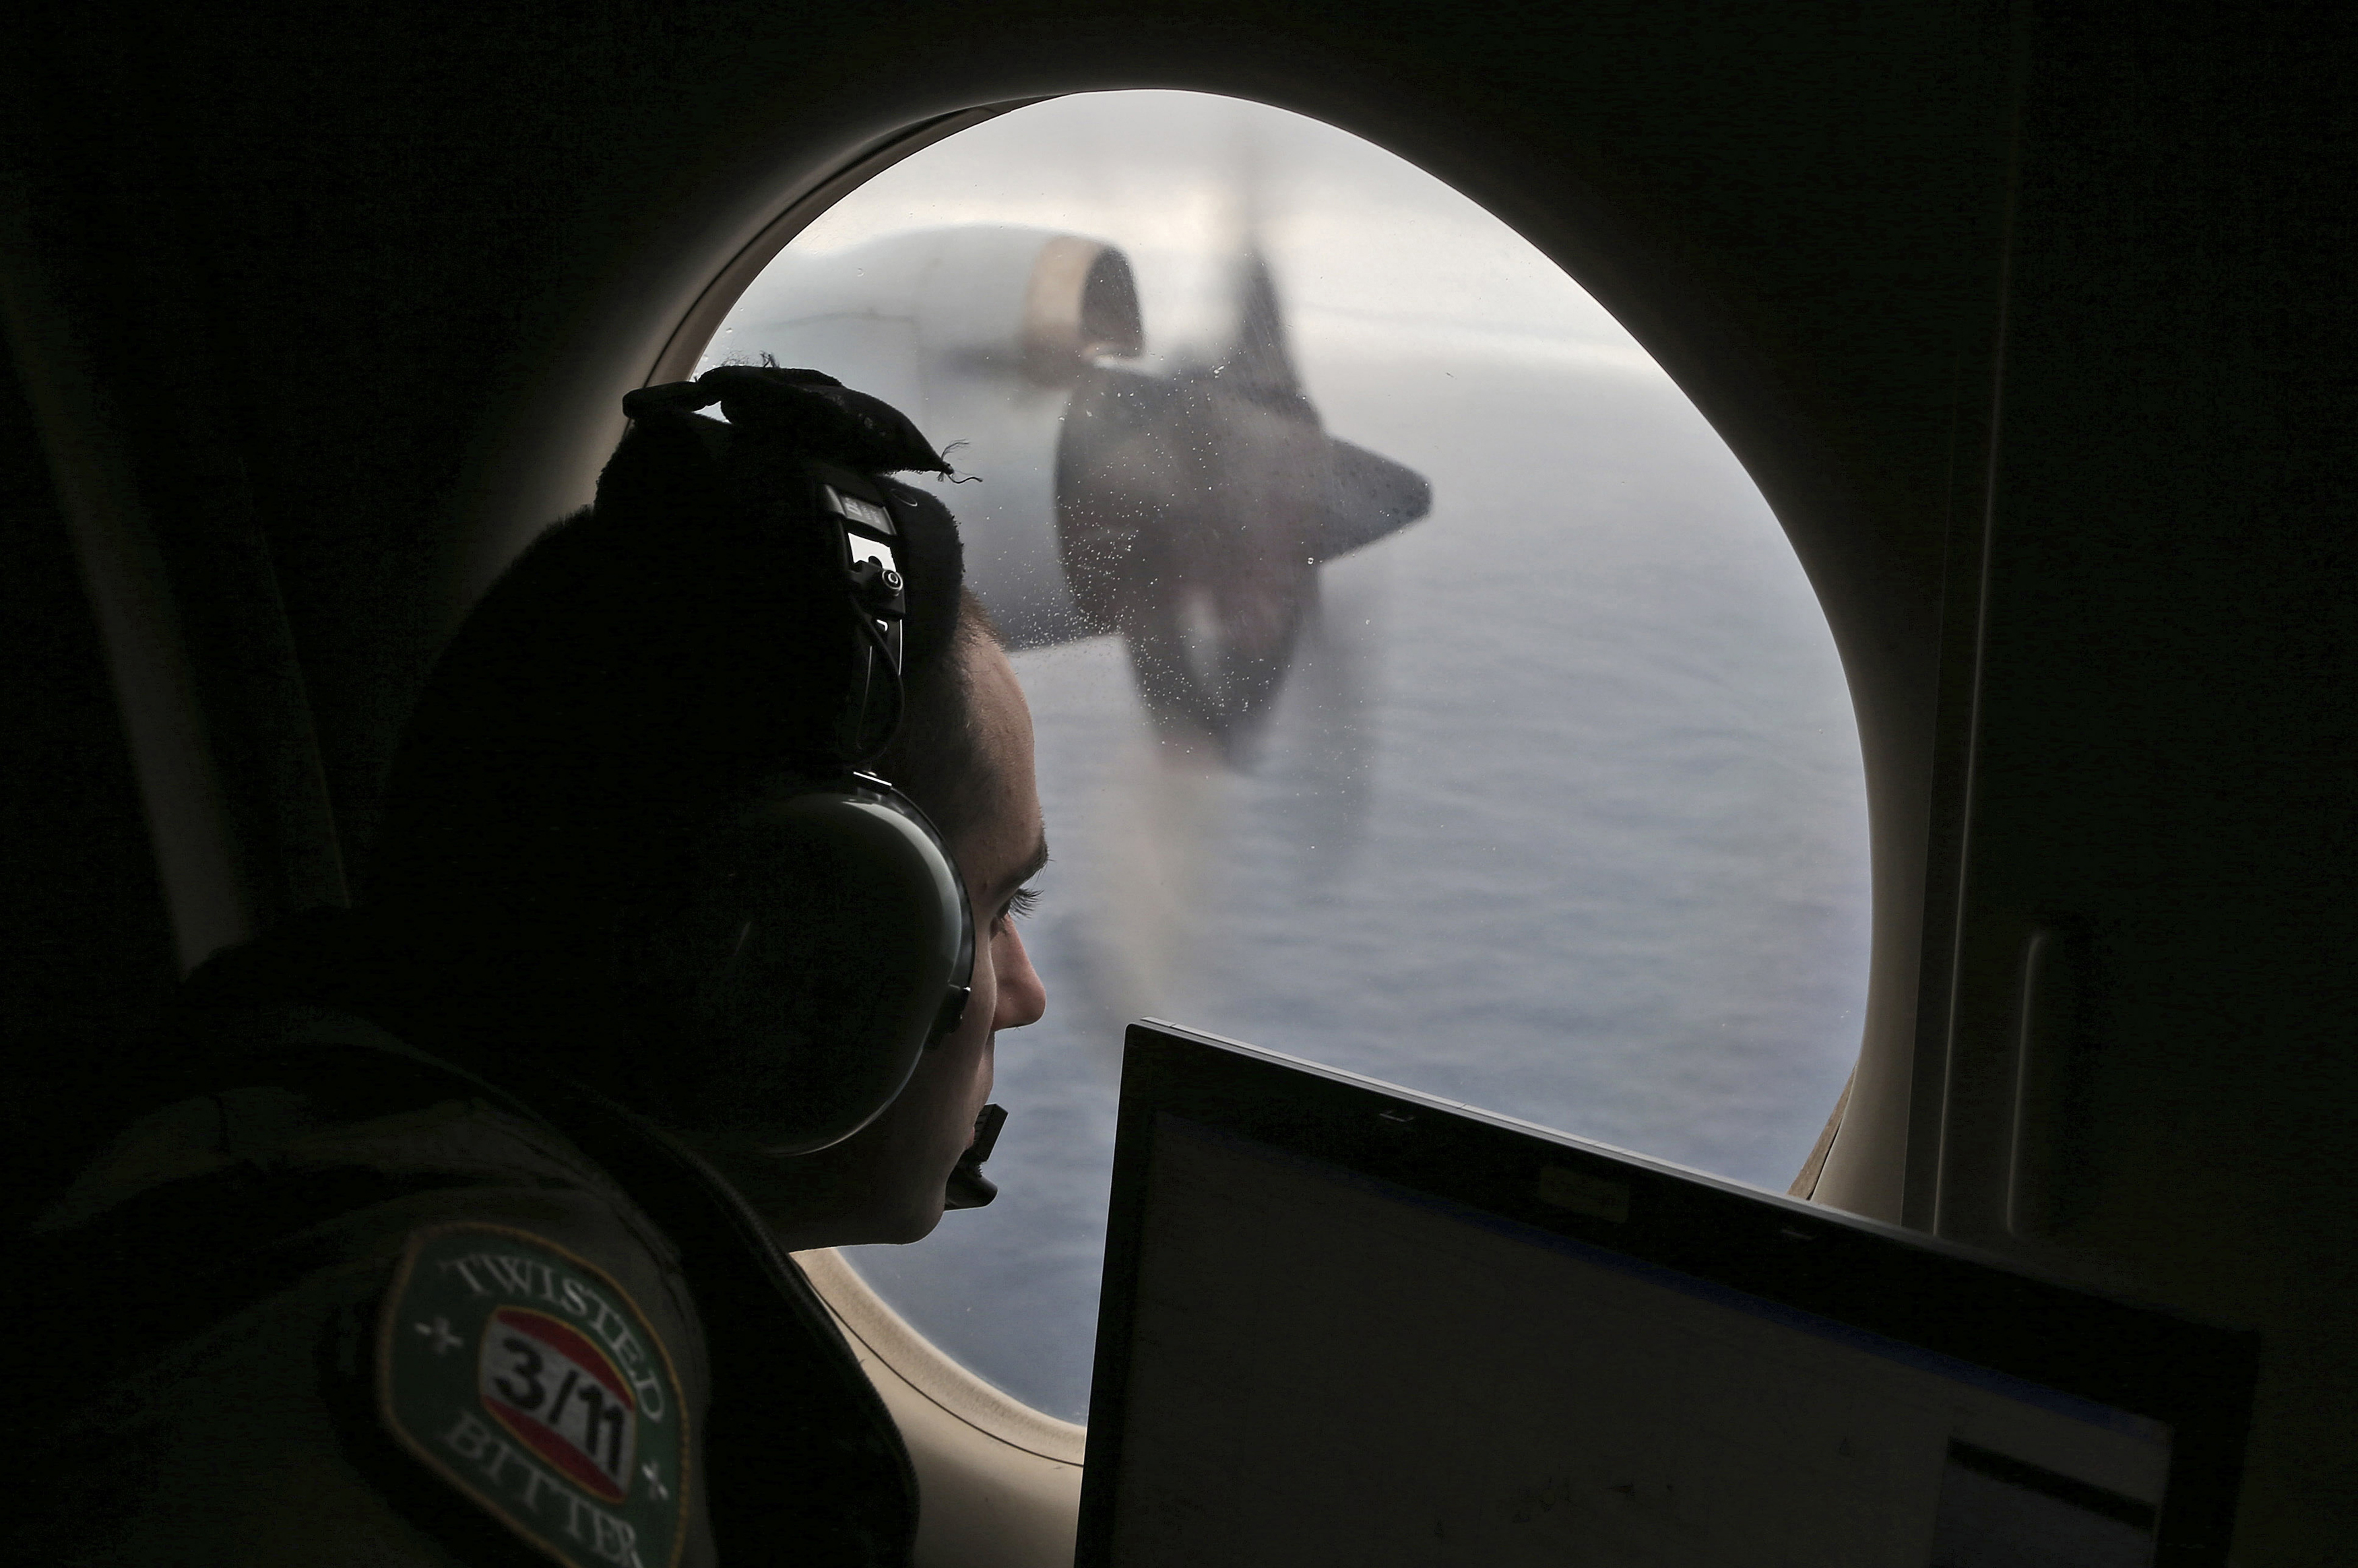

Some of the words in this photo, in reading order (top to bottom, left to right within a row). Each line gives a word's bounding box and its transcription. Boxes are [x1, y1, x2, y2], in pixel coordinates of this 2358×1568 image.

[439, 1253, 665, 1423] TWISTED
[492, 1338, 627, 1472] 3/11
[441, 1412, 644, 1568] BITTER
